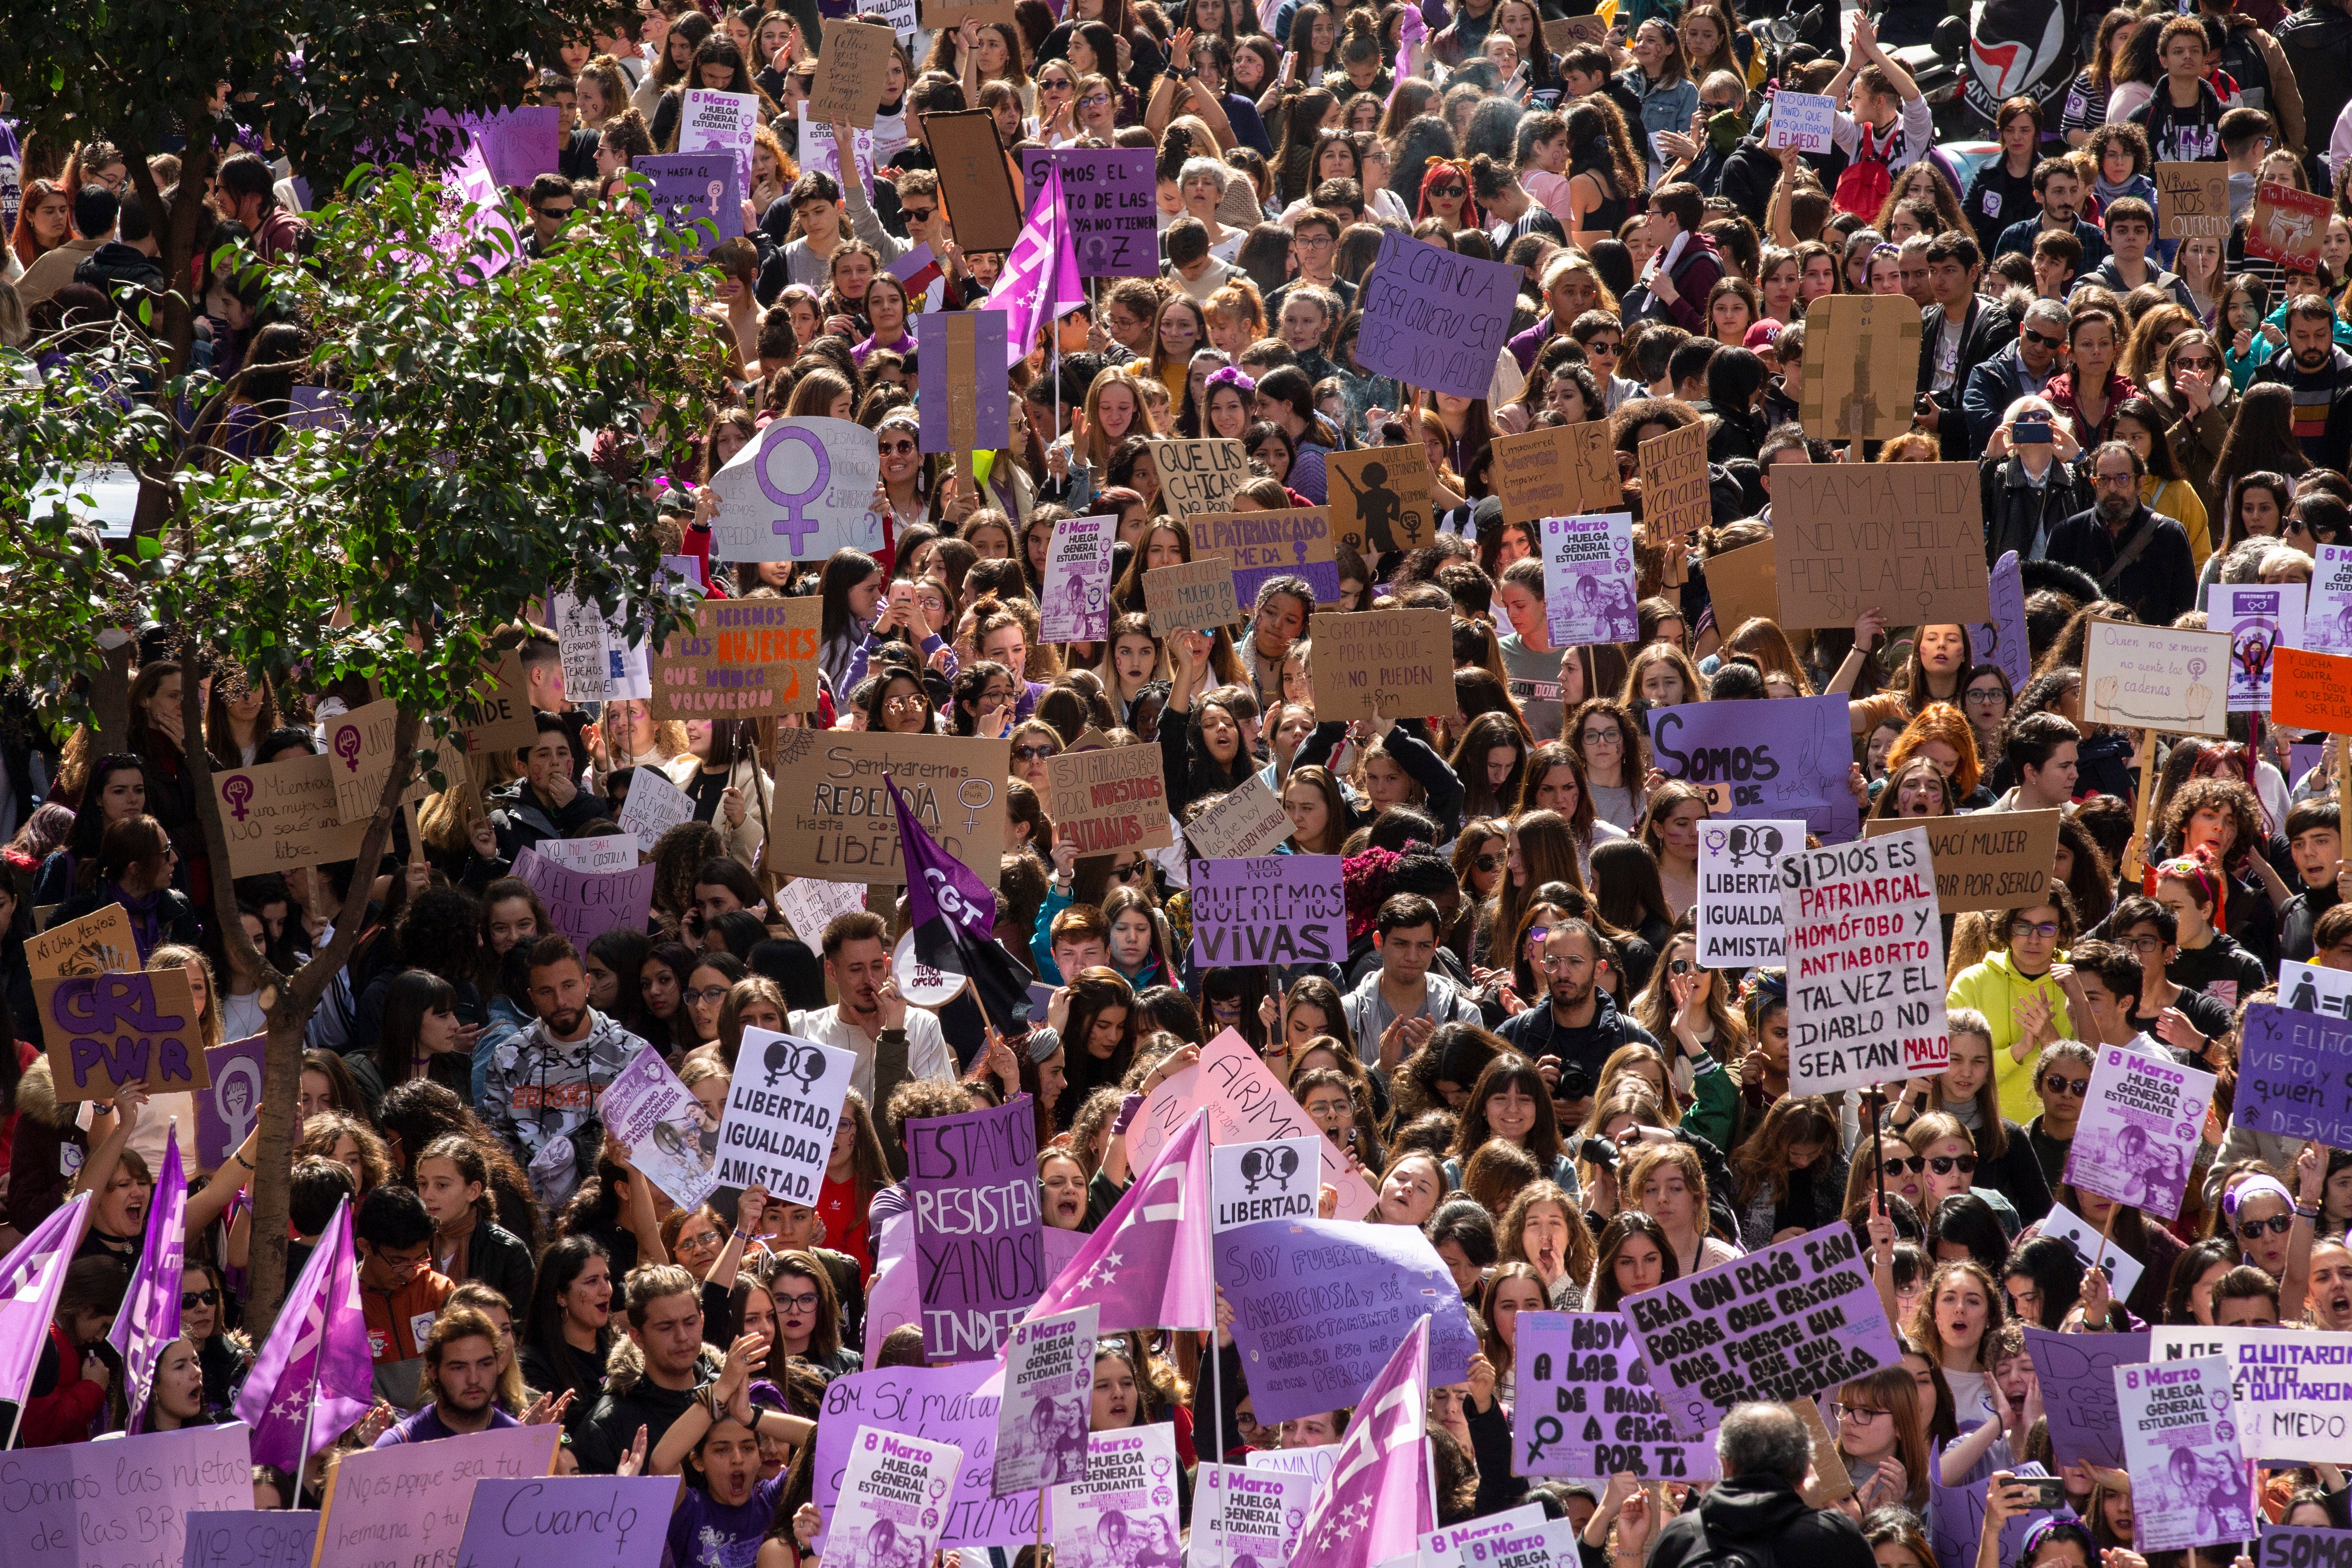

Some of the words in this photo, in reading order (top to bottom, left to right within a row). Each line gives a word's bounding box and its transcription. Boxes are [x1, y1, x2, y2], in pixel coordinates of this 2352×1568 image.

[692, 92, 700, 102] 8
[704, 93, 740, 107] Marzo
[1777, 93, 1794, 104] NOS
[700, 113, 738, 123] GENERAL
[705, 106, 739, 116] HUELGA
[1806, 111, 1822, 121] QUE
[692, 121, 737, 130] ESTUDIANTIL
[1773, 119, 1788, 128] NOS
[1108, 164, 1126, 180] EL
[1095, 193, 1113, 209] DE
[1119, 192, 1147, 208] LAS
[2173, 193, 2205, 213] NOS
[1114, 215, 1157, 230] TIENEN
[2171, 215, 2230, 237] QUEREMOS
[2279, 250, 2315, 267] ASCO
[1410, 248, 1474, 297] CAMINO
[1366, 276, 1407, 321] CASA
[825, 428, 872, 447] DESNUDA
[845, 448, 859, 459] TE
[1159, 444, 1202, 473] QUE
[1213, 442, 1242, 469] LAS
[1381, 450, 1401, 463] QUE
[1388, 459, 1426, 479] FEMINISMO
[1646, 465, 1665, 491] ME
[1664, 451, 1701, 482] VISTO
[1788, 470, 1903, 516] MAMÁ
[1914, 473, 1972, 514] HOY
[1069, 521, 1100, 533] Marzo
[1549, 521, 1559, 534] 8
[1564, 520, 1609, 533] Marzo
[1664, 500, 1711, 539] DESVISTO
[1068, 533, 1099, 544] HUELGA
[1214, 516, 1327, 548] PATRIARCADO
[1568, 532, 1609, 543] HUELGA
[1796, 523, 1834, 551] NO
[1848, 522, 1893, 550] VOY
[1902, 520, 1977, 549] SOLA
[1056, 551, 1098, 562] ESTUDIANTIL
[1063, 543, 1098, 554] GENERAL
[1262, 547, 1282, 564] DA
[1556, 552, 1611, 563] ESTUDIANTIL
[1562, 542, 1610, 554] GENERAL
[1790, 558, 1847, 593] POR
[1178, 582, 1216, 603] MUCHO
[716, 606, 786, 627] DEBEMOS
[1163, 603, 1222, 630] LUCHAR
[564, 624, 606, 638] PUERTAS
[1330, 618, 1412, 642] GRITAMOS
[2104, 627, 2140, 647] Quien
[2180, 644, 2209, 653] mueve
[561, 640, 602, 655] CERRADAS
[718, 628, 818, 664] MUJERES
[1339, 644, 1367, 662] POR
[1370, 642, 1393, 660] LAS
[2137, 659, 2164, 673] siente
[2299, 656, 2332, 669] LUCHA
[581, 680, 611, 693] LLAVE
[663, 667, 697, 686] QUE
[706, 668, 764, 688] NUNCA
[1330, 672, 1348, 691] YA
[1349, 672, 1367, 688] NO
[1380, 665, 1433, 686] PUEDEN
[2124, 674, 2171, 697] cadenas
[2293, 669, 2332, 681] CONTRA
[2321, 682, 2346, 693] TODO
[669, 689, 773, 711] VOLVIERON
[2305, 703, 2328, 715] SER
[1654, 712, 1781, 783] SOMOS
[825, 746, 969, 780] Sembraremos
[1087, 746, 1159, 783] MIRASES
[263, 774, 334, 797] Mientras
[1090, 775, 1162, 809] NUESTROS
[282, 797, 320, 816] mujer
[812, 781, 941, 824] REBELDÍA
[1107, 800, 1142, 816] OJOS
[797, 815, 843, 832] hasta
[1972, 830, 2027, 854] MUJER
[594, 851, 627, 867] COSTILLA
[1245, 859, 1285, 881] NOS
[1813, 846, 1878, 880] DIOS
[1888, 841, 1916, 869] ES
[1996, 869, 2043, 896] SERLO
[835, 891, 853, 909] ENTRE
[923, 868, 984, 926] CGT
[1799, 873, 1931, 918] PATRIARCAL
[78, 915, 116, 944] MENOS
[550, 903, 594, 934] QUE
[1800, 941, 1929, 978] ANTIABORTO
[1903, 965, 1938, 995] EL
[54, 973, 185, 1034] GRL
[1897, 1002, 1930, 1029] NO
[70, 1036, 192, 1088] PWR
[1799, 1050, 1847, 1077] SEA
[2126, 1054, 2185, 1085] Marzo
[2249, 1048, 2316, 1079] VISTO
[2116, 1083, 2178, 1109] GENERAL
[2126, 1073, 2180, 1097] HUELGA
[626, 1090, 659, 1127] FEMINISMO
[733, 1086, 832, 1137] LIBERTAD,
[2104, 1090, 2175, 1118] ESTUDIANTIL
[631, 1092, 682, 1145] ANTICAPITALISTA
[725, 1121, 823, 1171] IGUALDAD,
[1220, 1193, 1314, 1224] LIBERTAD,
[1226, 1245, 1280, 1287] SOY
[1630, 1290, 1692, 1334] ERA
[1691, 1273, 1736, 1310] UN
[1804, 1231, 1857, 1274] TAN
[1243, 1282, 1358, 1330] AMBICIOSA
[1029, 1320, 1076, 1342] Marzo
[1645, 1317, 1727, 1366] POBRE
[1727, 1302, 1776, 1332] QUE
[1724, 1322, 1803, 1367] FUERTE
[1806, 1306, 1846, 1336] UN
[1032, 1334, 1075, 1355] HUELGA
[1793, 1335, 1842, 1366] UNA
[1025, 1350, 1074, 1370] GENERAL
[1533, 1354, 1552, 1381] A
[1566, 1352, 1618, 1382] LAS
[1016, 1362, 1073, 1385] ESTUDIANTIL
[1312, 1361, 1373, 1392] PERRA
[2126, 1372, 2138, 1389] 8
[2145, 1367, 2201, 1386] Marzo
[873, 1383, 909, 1421] Si
[1556, 1386, 1587, 1413] DE
[2151, 1384, 2204, 1402] HUELGA
[2146, 1397, 2207, 1417] GENERAL
[2138, 1412, 2209, 1431] ESTUDIANTIL
[2273, 1412, 2346, 1438] MIEDO
[864, 1433, 878, 1451] 8
[880, 1437, 933, 1464] Marzo
[1087, 1452, 1144, 1468] HUELGA
[1594, 1444, 1648, 1476] POR
[453, 1459, 486, 1482] sea
[881, 1457, 929, 1478] HUELGA
[1085, 1466, 1145, 1480] GENERAL
[1, 1460, 101, 1513] Somos
[116, 1456, 162, 1495] las
[858, 1481, 922, 1504] ESTUDIANTIL
[870, 1470, 925, 1492] GENERAL
[1071, 1479, 1147, 1495] ESTUDIANTIL
[1228, 1472, 1284, 1496] Marzo
[1230, 1493, 1282, 1510] HUELGA
[1224, 1507, 1281, 1524] GENERAL
[30, 1521, 70, 1551] de
[80, 1511, 127, 1546] las
[337, 1522, 411, 1550] hermana
[1210, 1520, 1281, 1537] ESTUDIANTIL
[1431, 1535, 1447, 1553] 8
[1473, 1543, 1486, 1561] 8
[1490, 1535, 1545, 1557] Marzo
